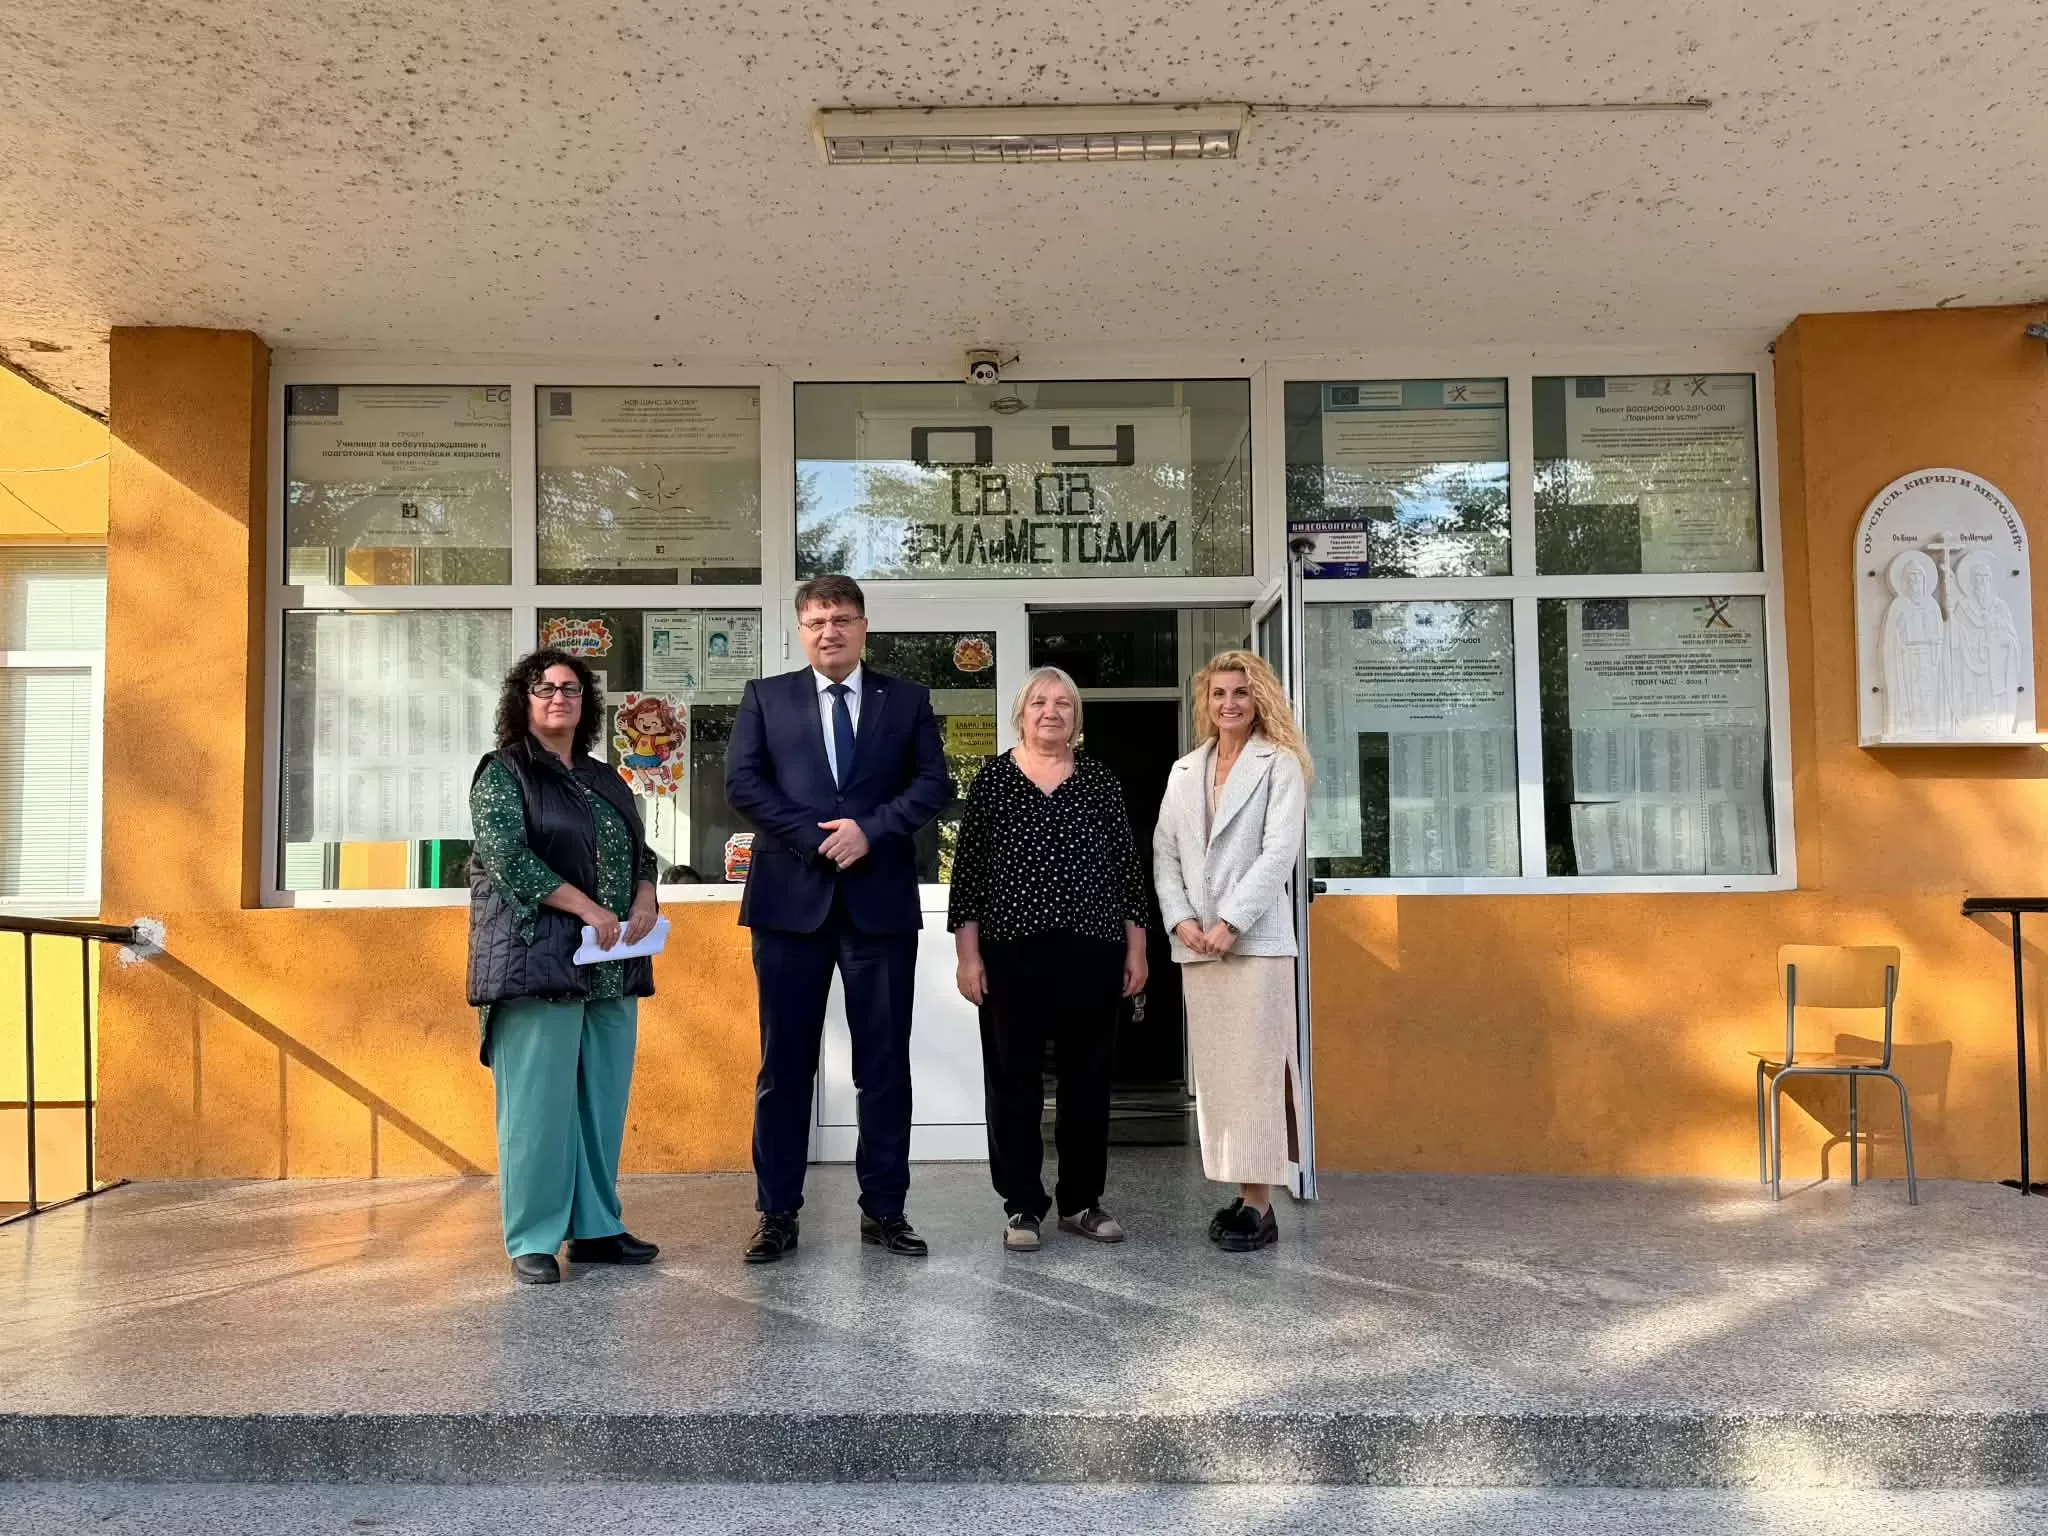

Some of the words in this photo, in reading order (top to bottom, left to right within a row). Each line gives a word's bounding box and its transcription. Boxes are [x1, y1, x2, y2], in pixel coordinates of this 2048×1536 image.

[1051, 424, 1135, 467] У
[1904, 475, 1956, 491] КИРИЛ
[1960, 478, 1971, 488] И
[1004, 514, 1177, 564] МЕТОДИЙ
